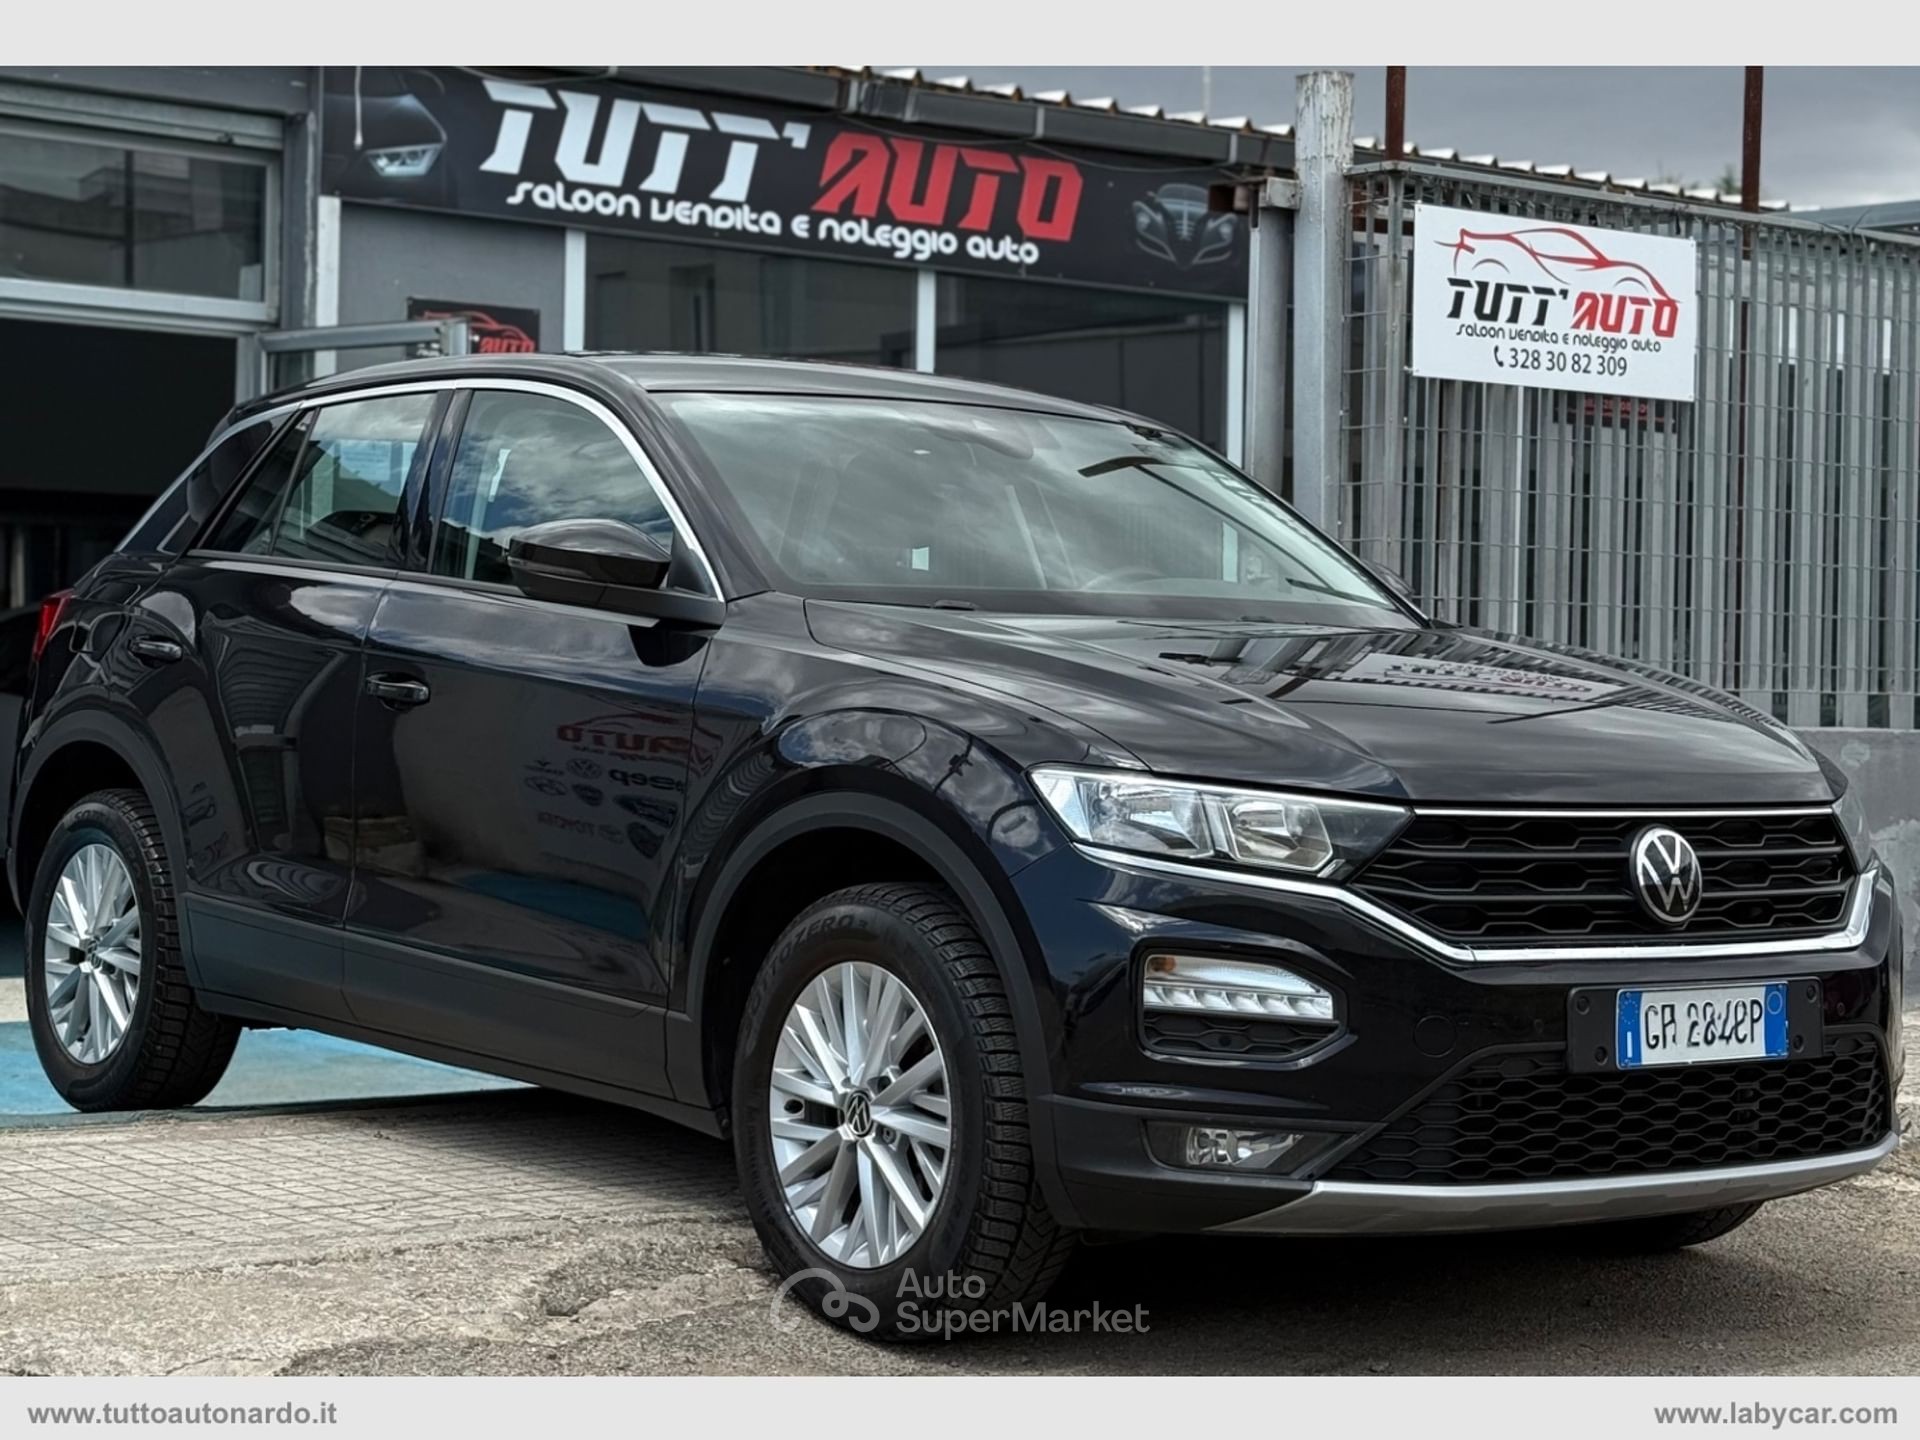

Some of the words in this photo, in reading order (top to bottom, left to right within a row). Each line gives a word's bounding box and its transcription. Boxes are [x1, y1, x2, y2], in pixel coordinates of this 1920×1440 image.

[810, 131, 1084, 242] AUTO
[1570, 291, 1679, 338] AUTO
[1509, 347, 1541, 370] 328
[1545, 350, 1567, 373] 30
[1571, 352, 1592, 375] 82
[1596, 355, 1628, 377] 309
